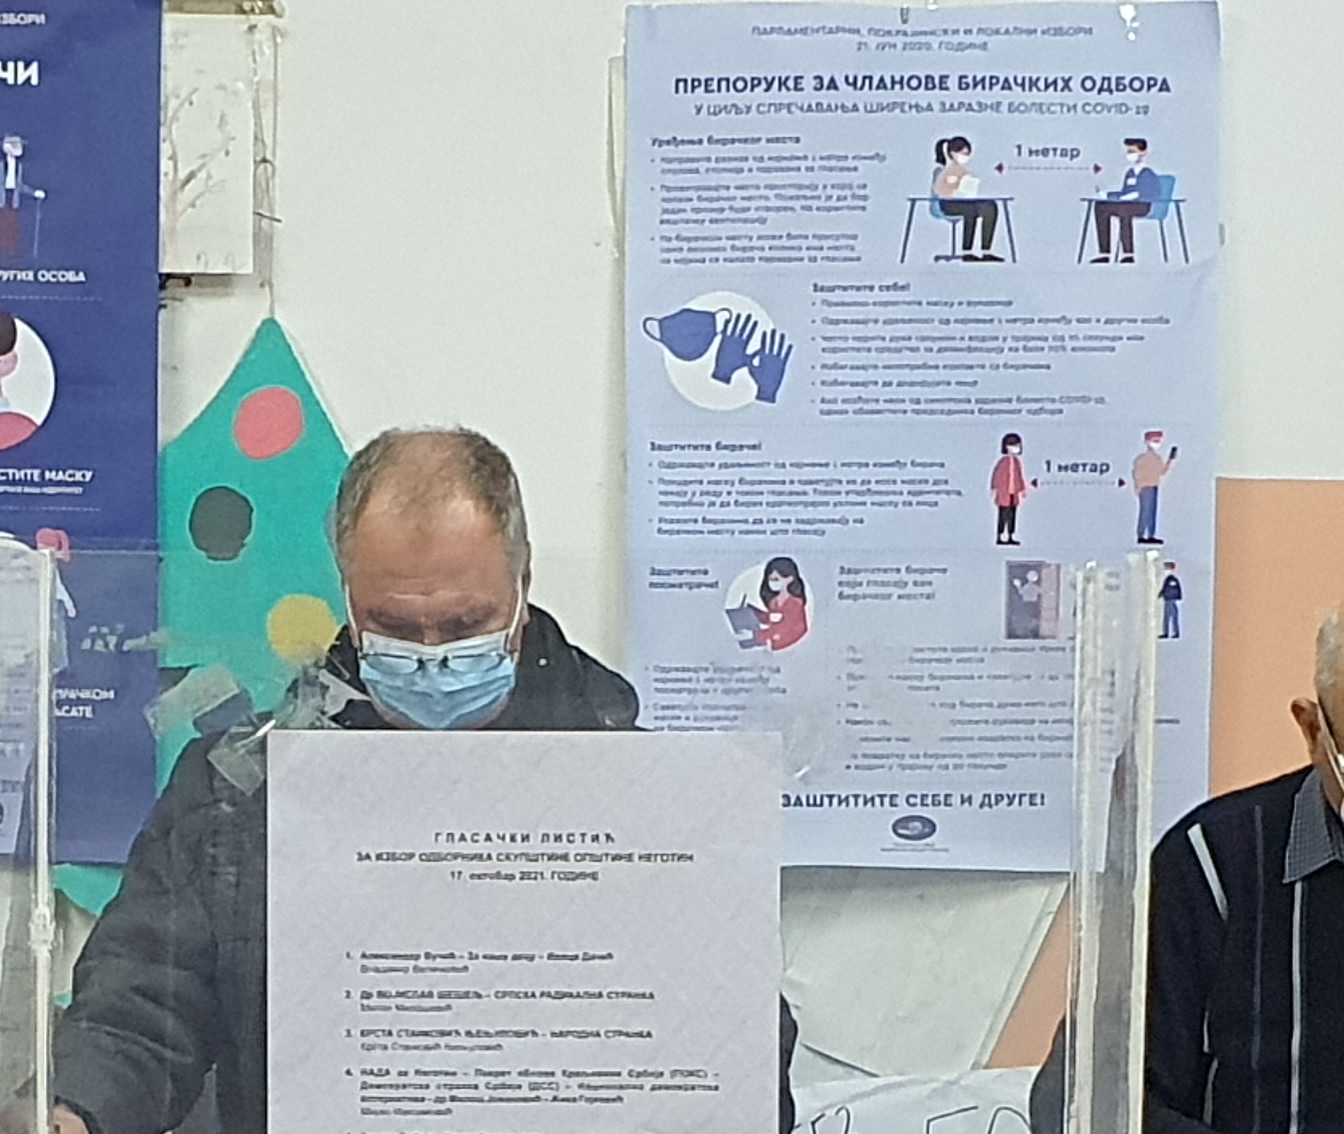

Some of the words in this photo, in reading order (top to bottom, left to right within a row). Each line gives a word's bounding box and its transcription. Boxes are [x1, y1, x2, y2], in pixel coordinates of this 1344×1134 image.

[674, 76, 805, 93] ПРЕПОРУКЕ
[812, 75, 840, 91] ЗА
[844, 75, 950, 91] ЧЛАНОВЕ
[957, 74, 1073, 92] БИРАЧКИХ
[1080, 75, 1171, 93] ОДБОРА
[706, 103, 753, 116] ЦИЉУ
[755, 101, 860, 114] СПРЕЧАВАЊА
[863, 100, 934, 113] ШИРЕЊА
[938, 100, 1003, 113] ЗАРАЗНЕ
[1007, 101, 1078, 114] БОЛЕСТИ
[37, 269, 86, 282] ОСОБА
[44, 469, 93, 481] МАСКУ
[782, 793, 899, 807] ЗАШТИТИТЕ
[905, 793, 953, 807] СЕБЕ
[978, 793, 1045, 808] ДРУГЕ!
[434, 832, 531, 842] ГЛАСАЧКИ
[540, 832, 615, 843] ЛИСТИЋ
